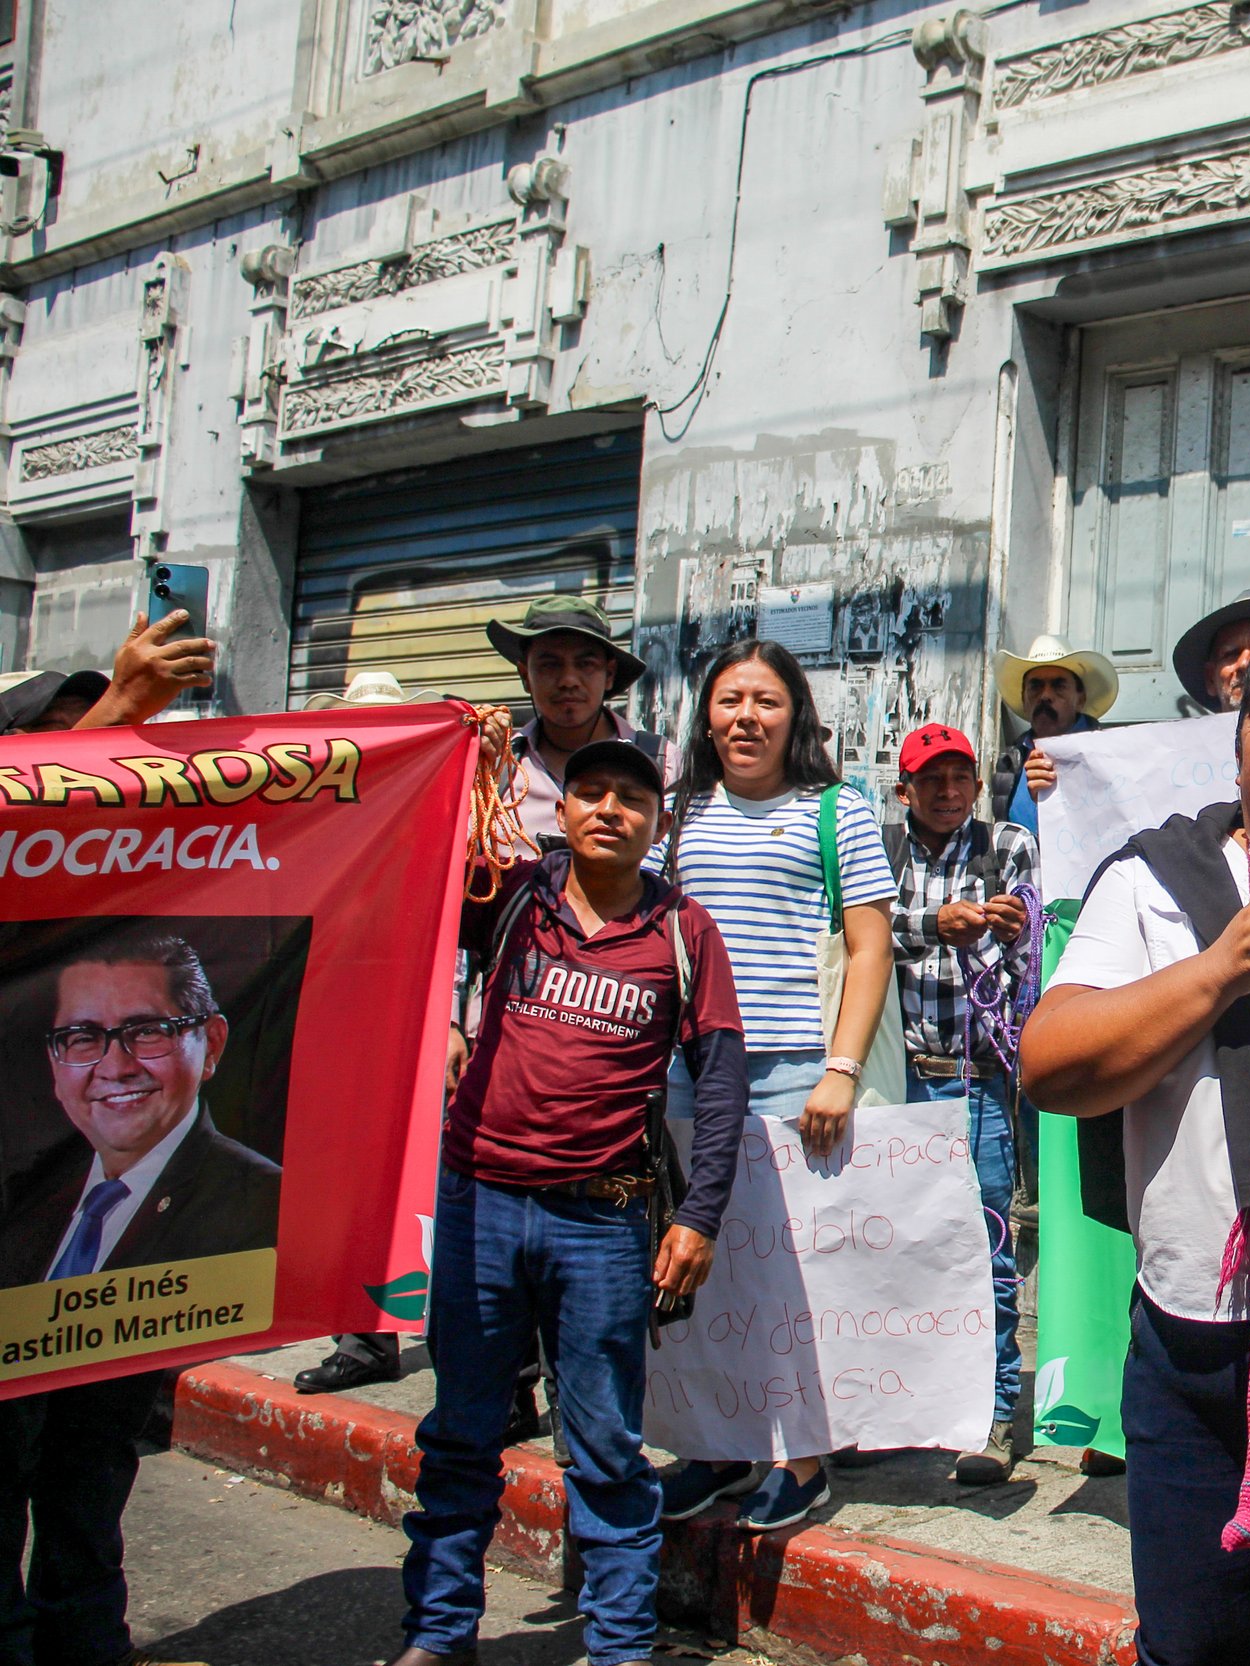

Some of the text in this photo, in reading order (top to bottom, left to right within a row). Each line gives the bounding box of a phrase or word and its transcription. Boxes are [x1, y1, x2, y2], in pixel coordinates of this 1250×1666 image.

[109, 737, 362, 809] ROSA
[504, 1000, 641, 1040] ATHLETIC DEPARTMENT
[540, 966, 658, 1026] ADIDAS
[47, 1268, 189, 1323] José Inés
[0, 1302, 245, 1366] astillo Martínez
